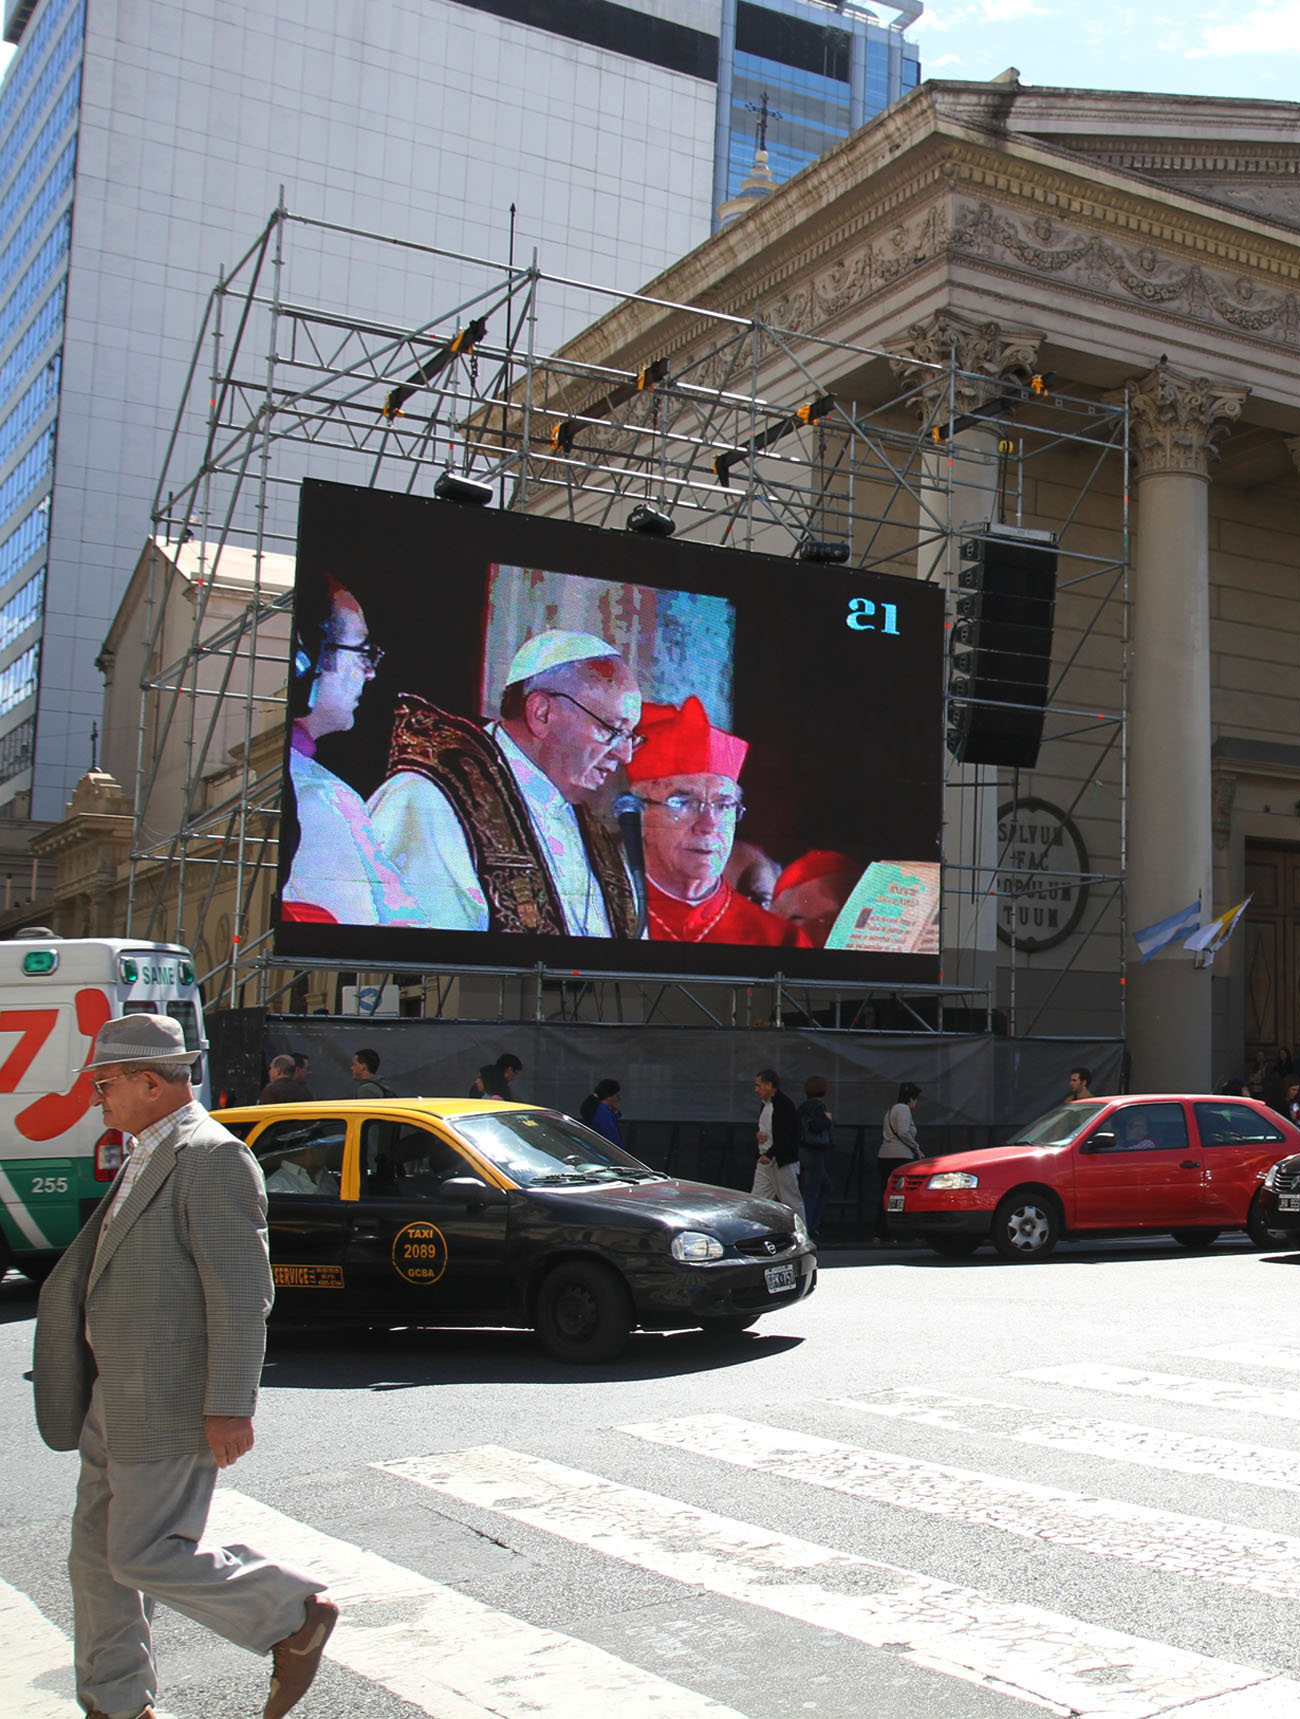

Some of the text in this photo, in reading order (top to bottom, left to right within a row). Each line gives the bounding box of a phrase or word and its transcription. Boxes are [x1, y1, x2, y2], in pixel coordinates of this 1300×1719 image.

[998, 877, 1072, 901] OPULUM
[1003, 905, 1059, 928] TUUM
[142, 966, 175, 985] SAME
[0, 1009, 60, 1093] 7
[31, 1177, 68, 1194] 255
[407, 1229, 434, 1239] TAXI
[403, 1243, 436, 1259] 2089
[274, 1267, 309, 1284] SERVICE
[407, 1268, 435, 1278] GCBA
